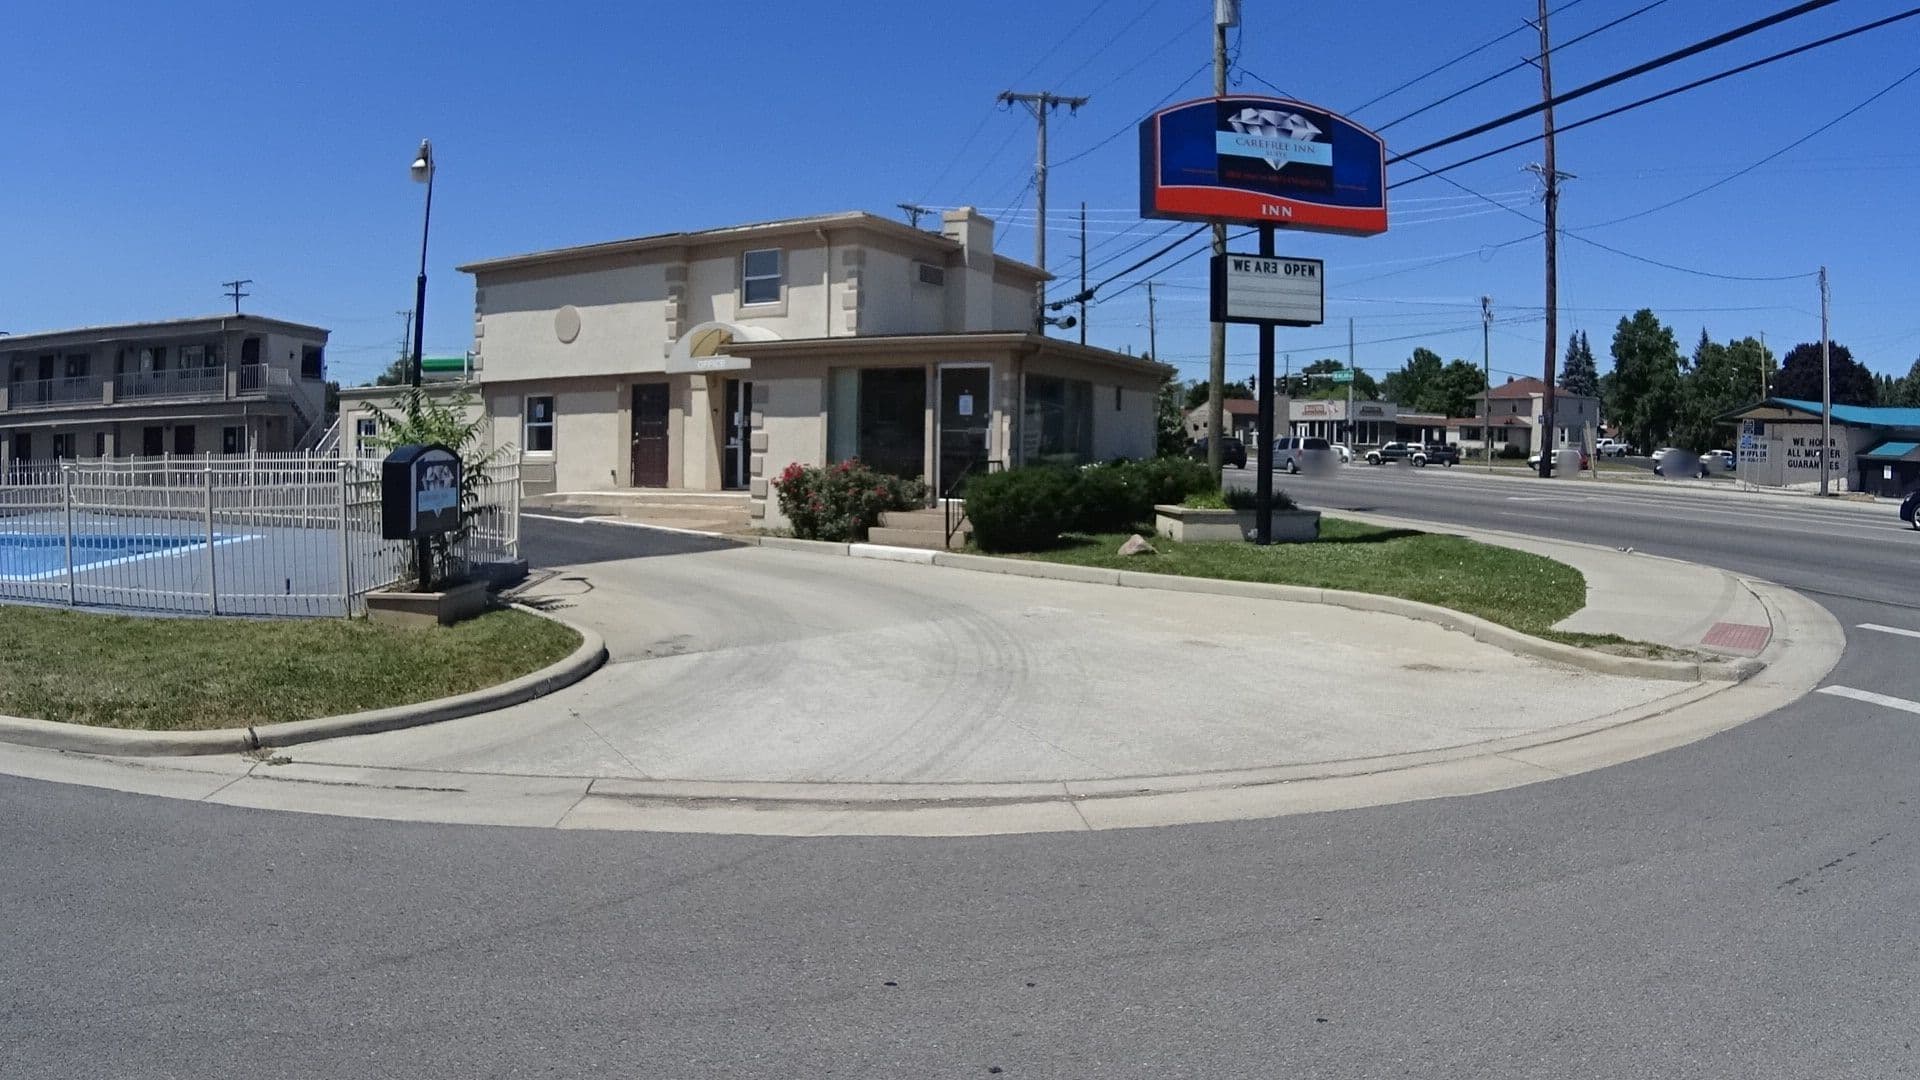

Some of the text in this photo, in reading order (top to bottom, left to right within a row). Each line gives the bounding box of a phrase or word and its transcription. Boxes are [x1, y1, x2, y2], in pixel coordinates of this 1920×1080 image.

[1235, 138, 1316, 153] CAREFREE INN
[1261, 204, 1292, 217] INN
[1233, 259, 1251, 272] WE
[1284, 263, 1316, 277] OPEN
[1793, 438, 1805, 447] WE
[1787, 449, 1801, 458] ALL
[1787, 460, 1840, 471] GUARANES
